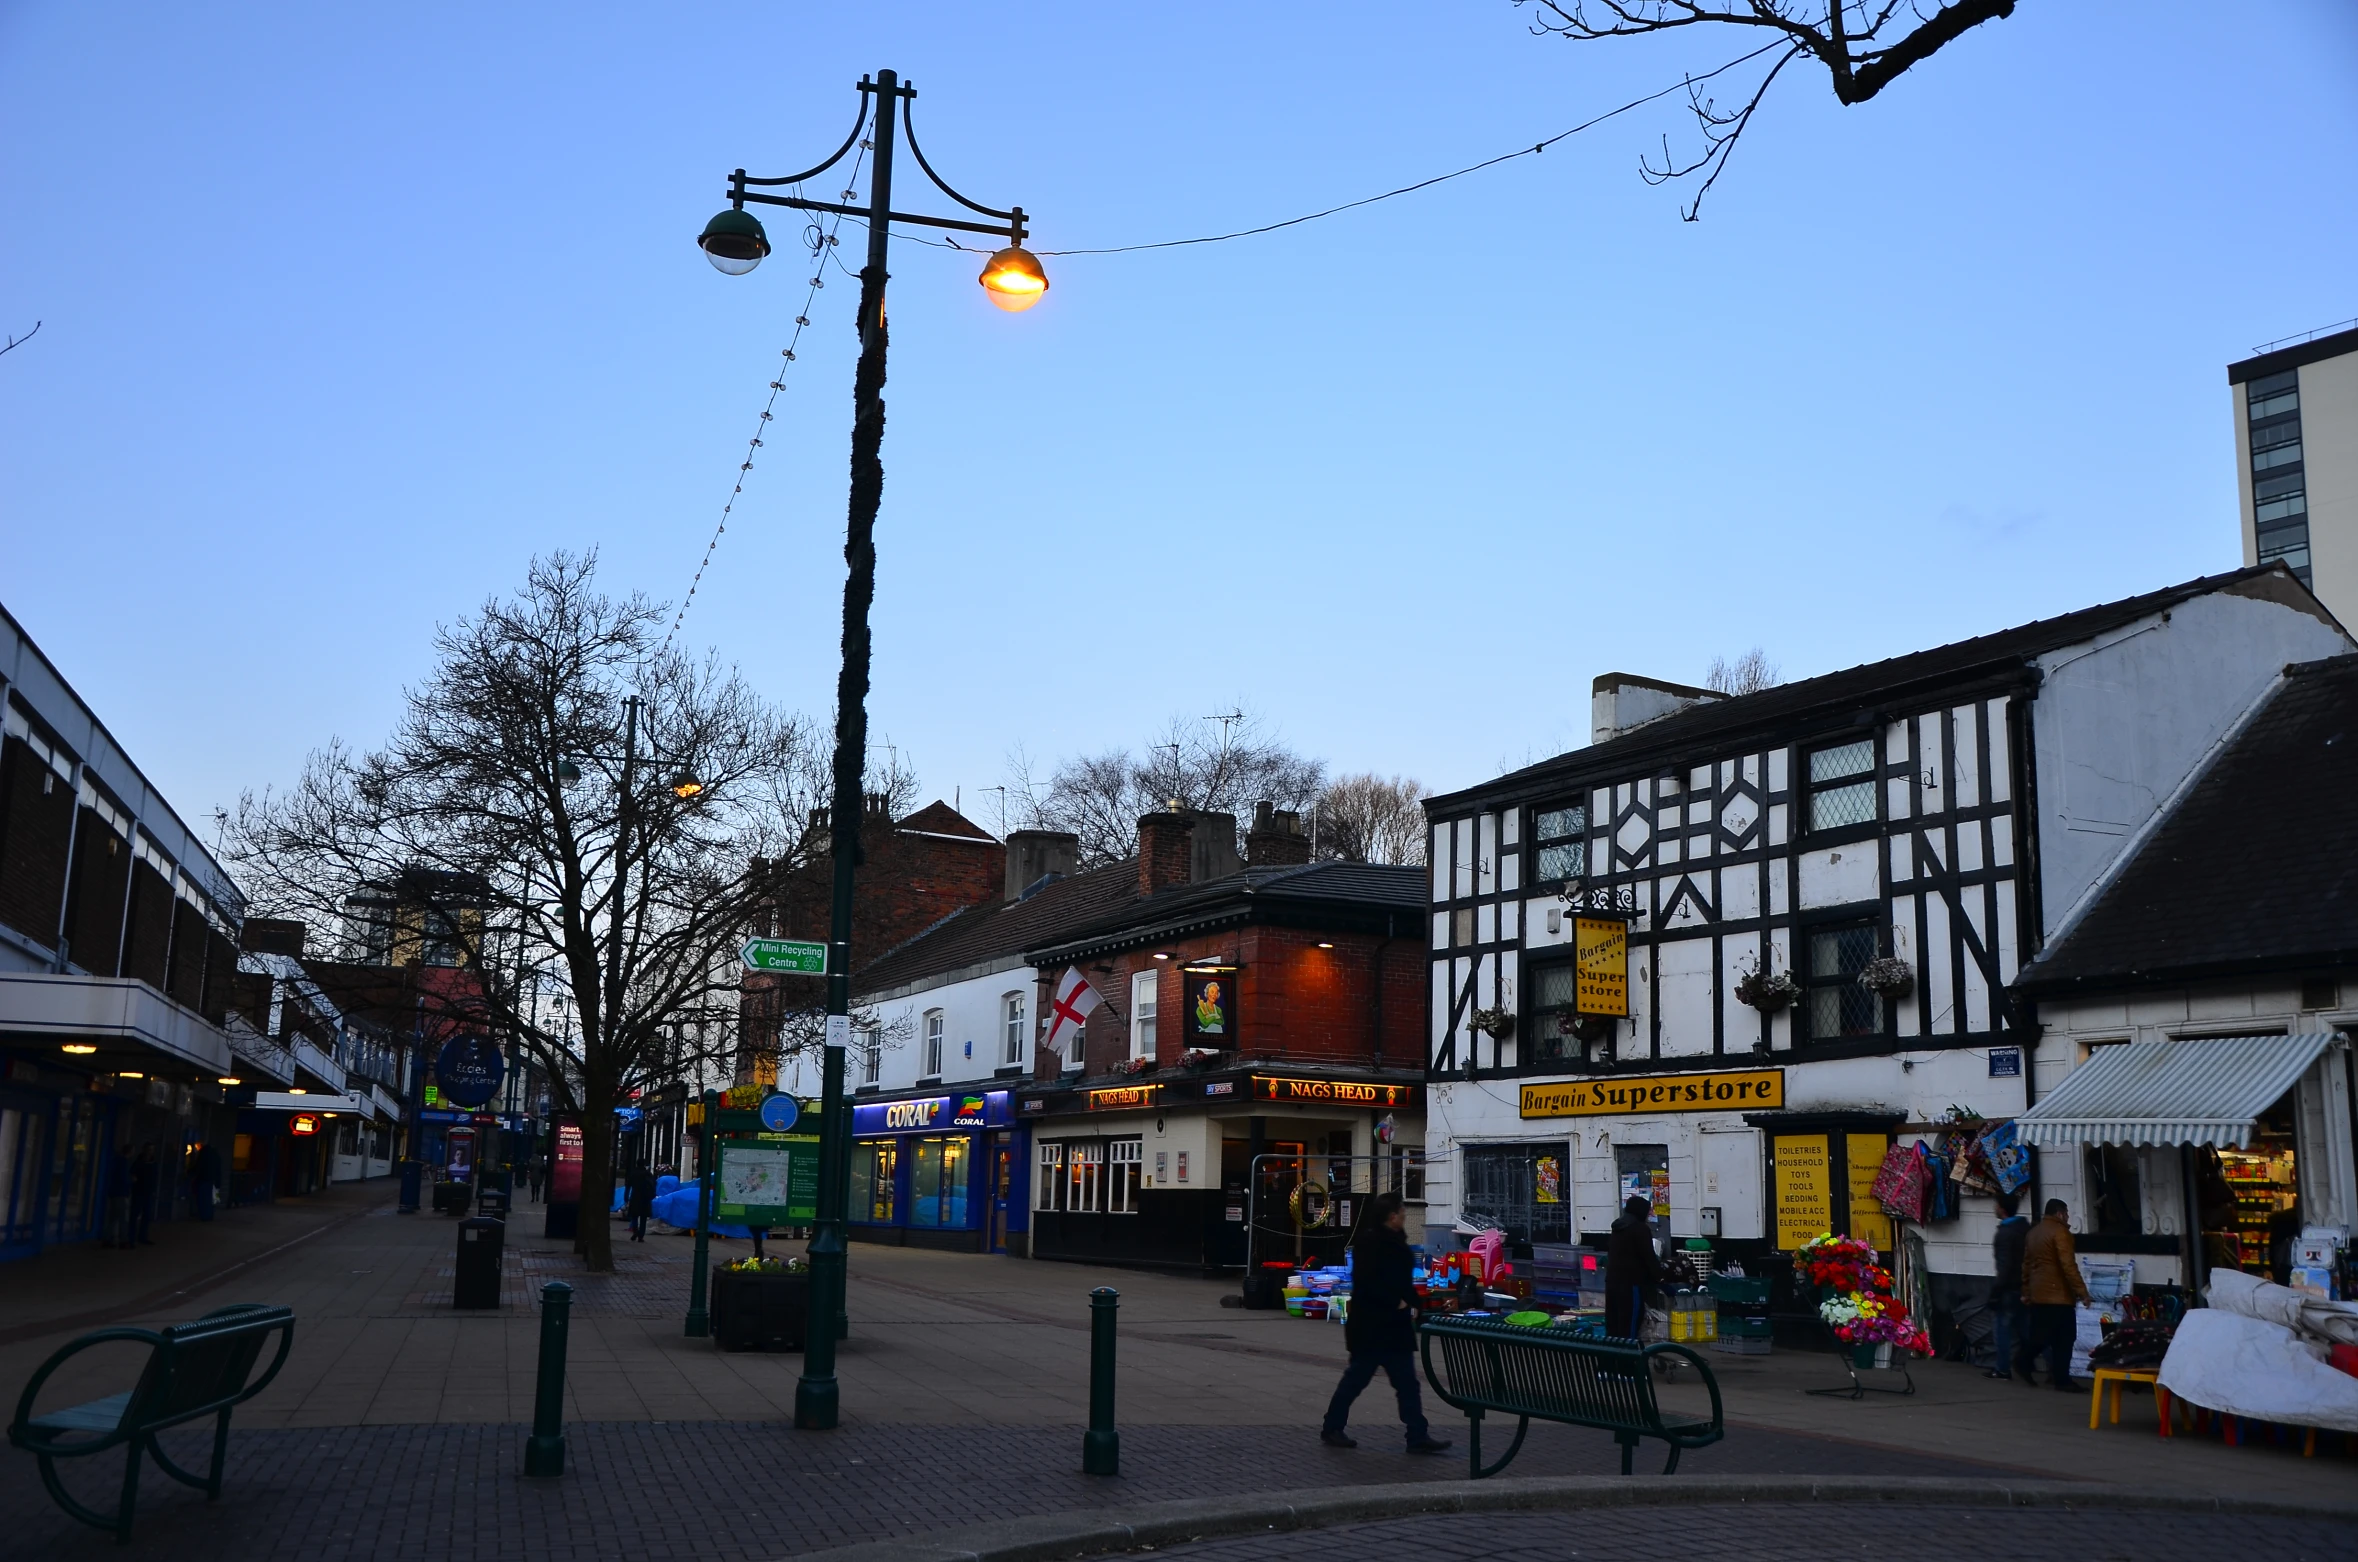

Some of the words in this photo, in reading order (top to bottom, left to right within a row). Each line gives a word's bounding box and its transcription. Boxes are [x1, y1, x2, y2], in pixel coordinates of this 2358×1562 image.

[761, 943, 779, 953] Mini
[781, 944, 822, 958] Recycling
[1580, 934, 1623, 961] Bargain
[768, 957, 797, 968] Centre
[1578, 968, 1624, 983] Super
[1581, 984, 1621, 996] store
[456, 1062, 487, 1074] Eccles
[1215, 1083, 1232, 1093] SPORTS
[1290, 1082, 1330, 1097] NAGS
[1334, 1085, 1376, 1100] HEAD
[1099, 1093, 1118, 1105] NAGS
[1119, 1091, 1139, 1103] HEAD
[1523, 1088, 1586, 1114] Bargain
[1591, 1078, 1771, 1110] Superstore
[886, 1102, 931, 1128] CORAL
